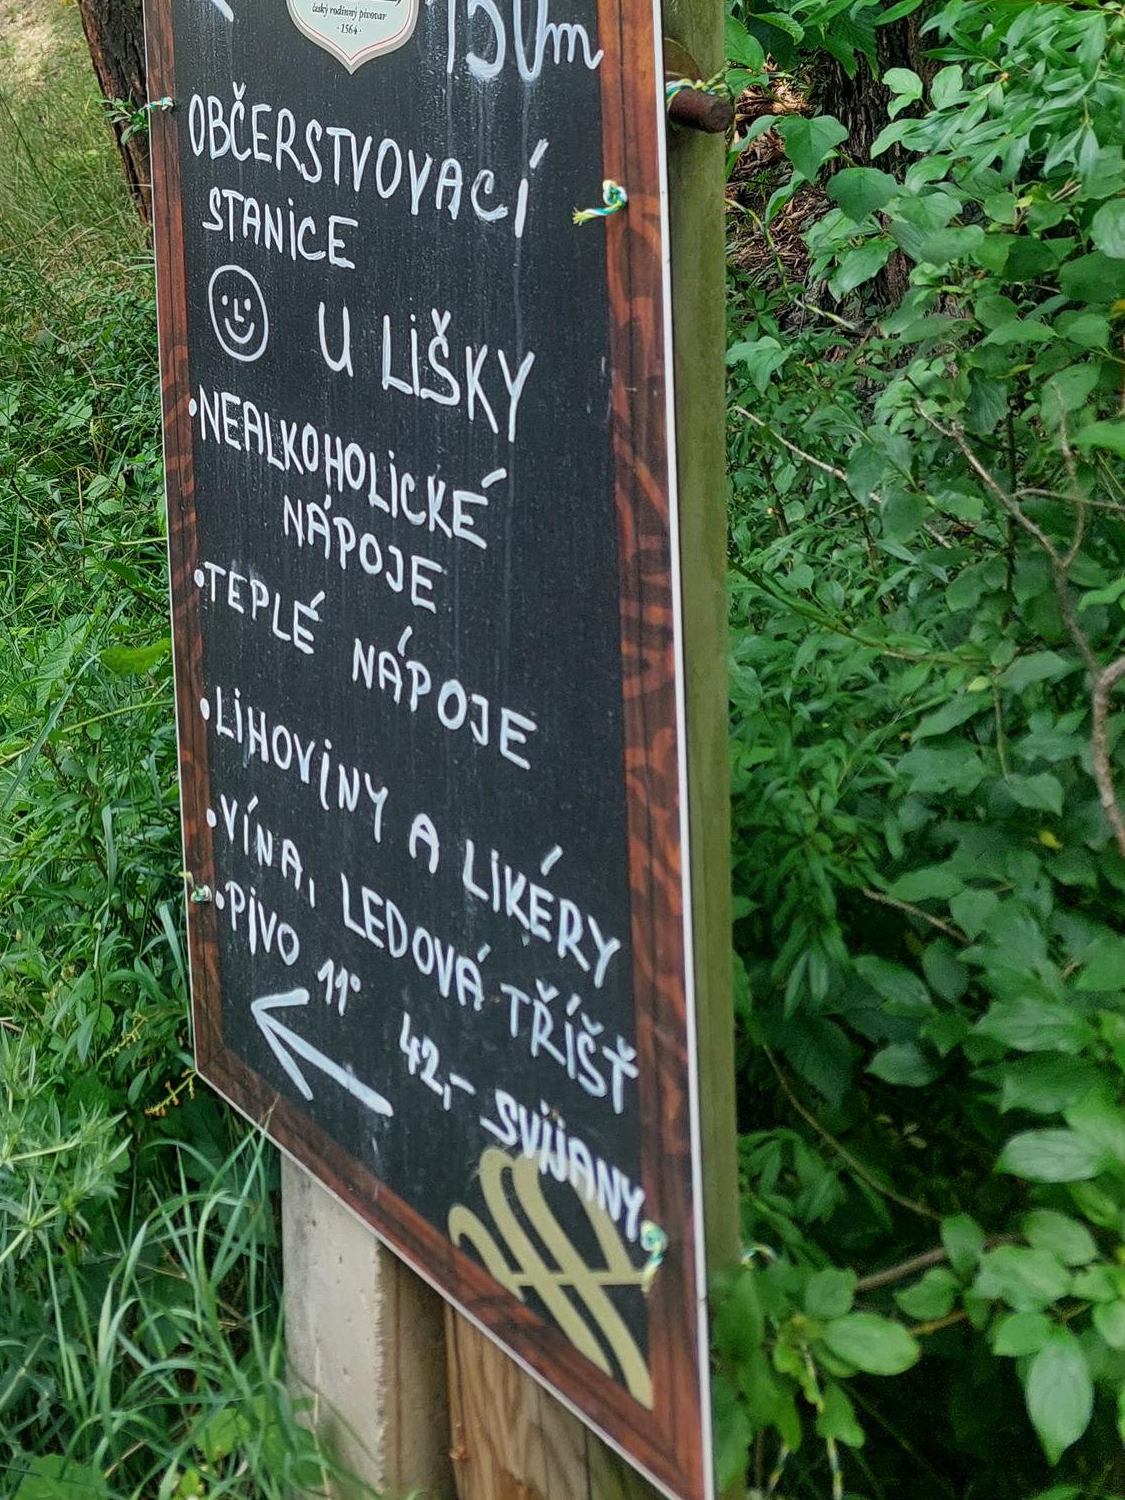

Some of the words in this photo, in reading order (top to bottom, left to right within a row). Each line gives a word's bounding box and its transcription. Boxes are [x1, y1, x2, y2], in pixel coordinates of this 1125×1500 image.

[188, 83, 548, 237] OBČERSTVOVACÍ
[318, 303, 352, 377] U
[283, 495, 446, 613] NÁPOJE
[204, 561, 325, 654] TEPLÉ
[352, 626, 538, 769] NÁPOJE
[409, 813, 439, 873] A
[341, 874, 490, 1011] LEDOVÁ
